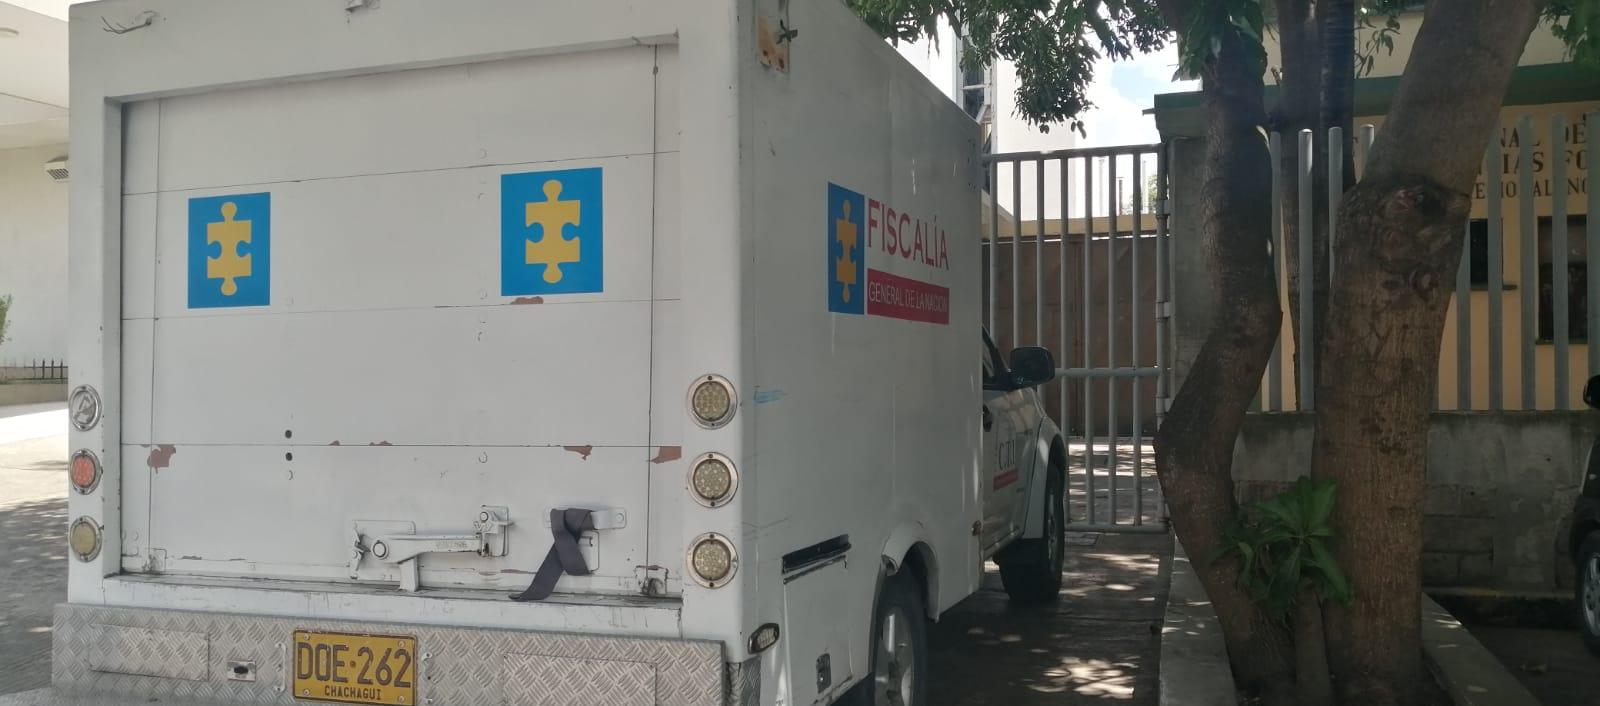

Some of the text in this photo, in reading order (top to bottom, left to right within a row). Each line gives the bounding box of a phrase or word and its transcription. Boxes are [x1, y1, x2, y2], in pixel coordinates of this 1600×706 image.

[868, 198, 949, 270] FISCALÍA
[868, 281, 904, 307] GENERAL
[905, 288, 915, 308] DE
[325, 685, 382, 701] CHACHAGUI
